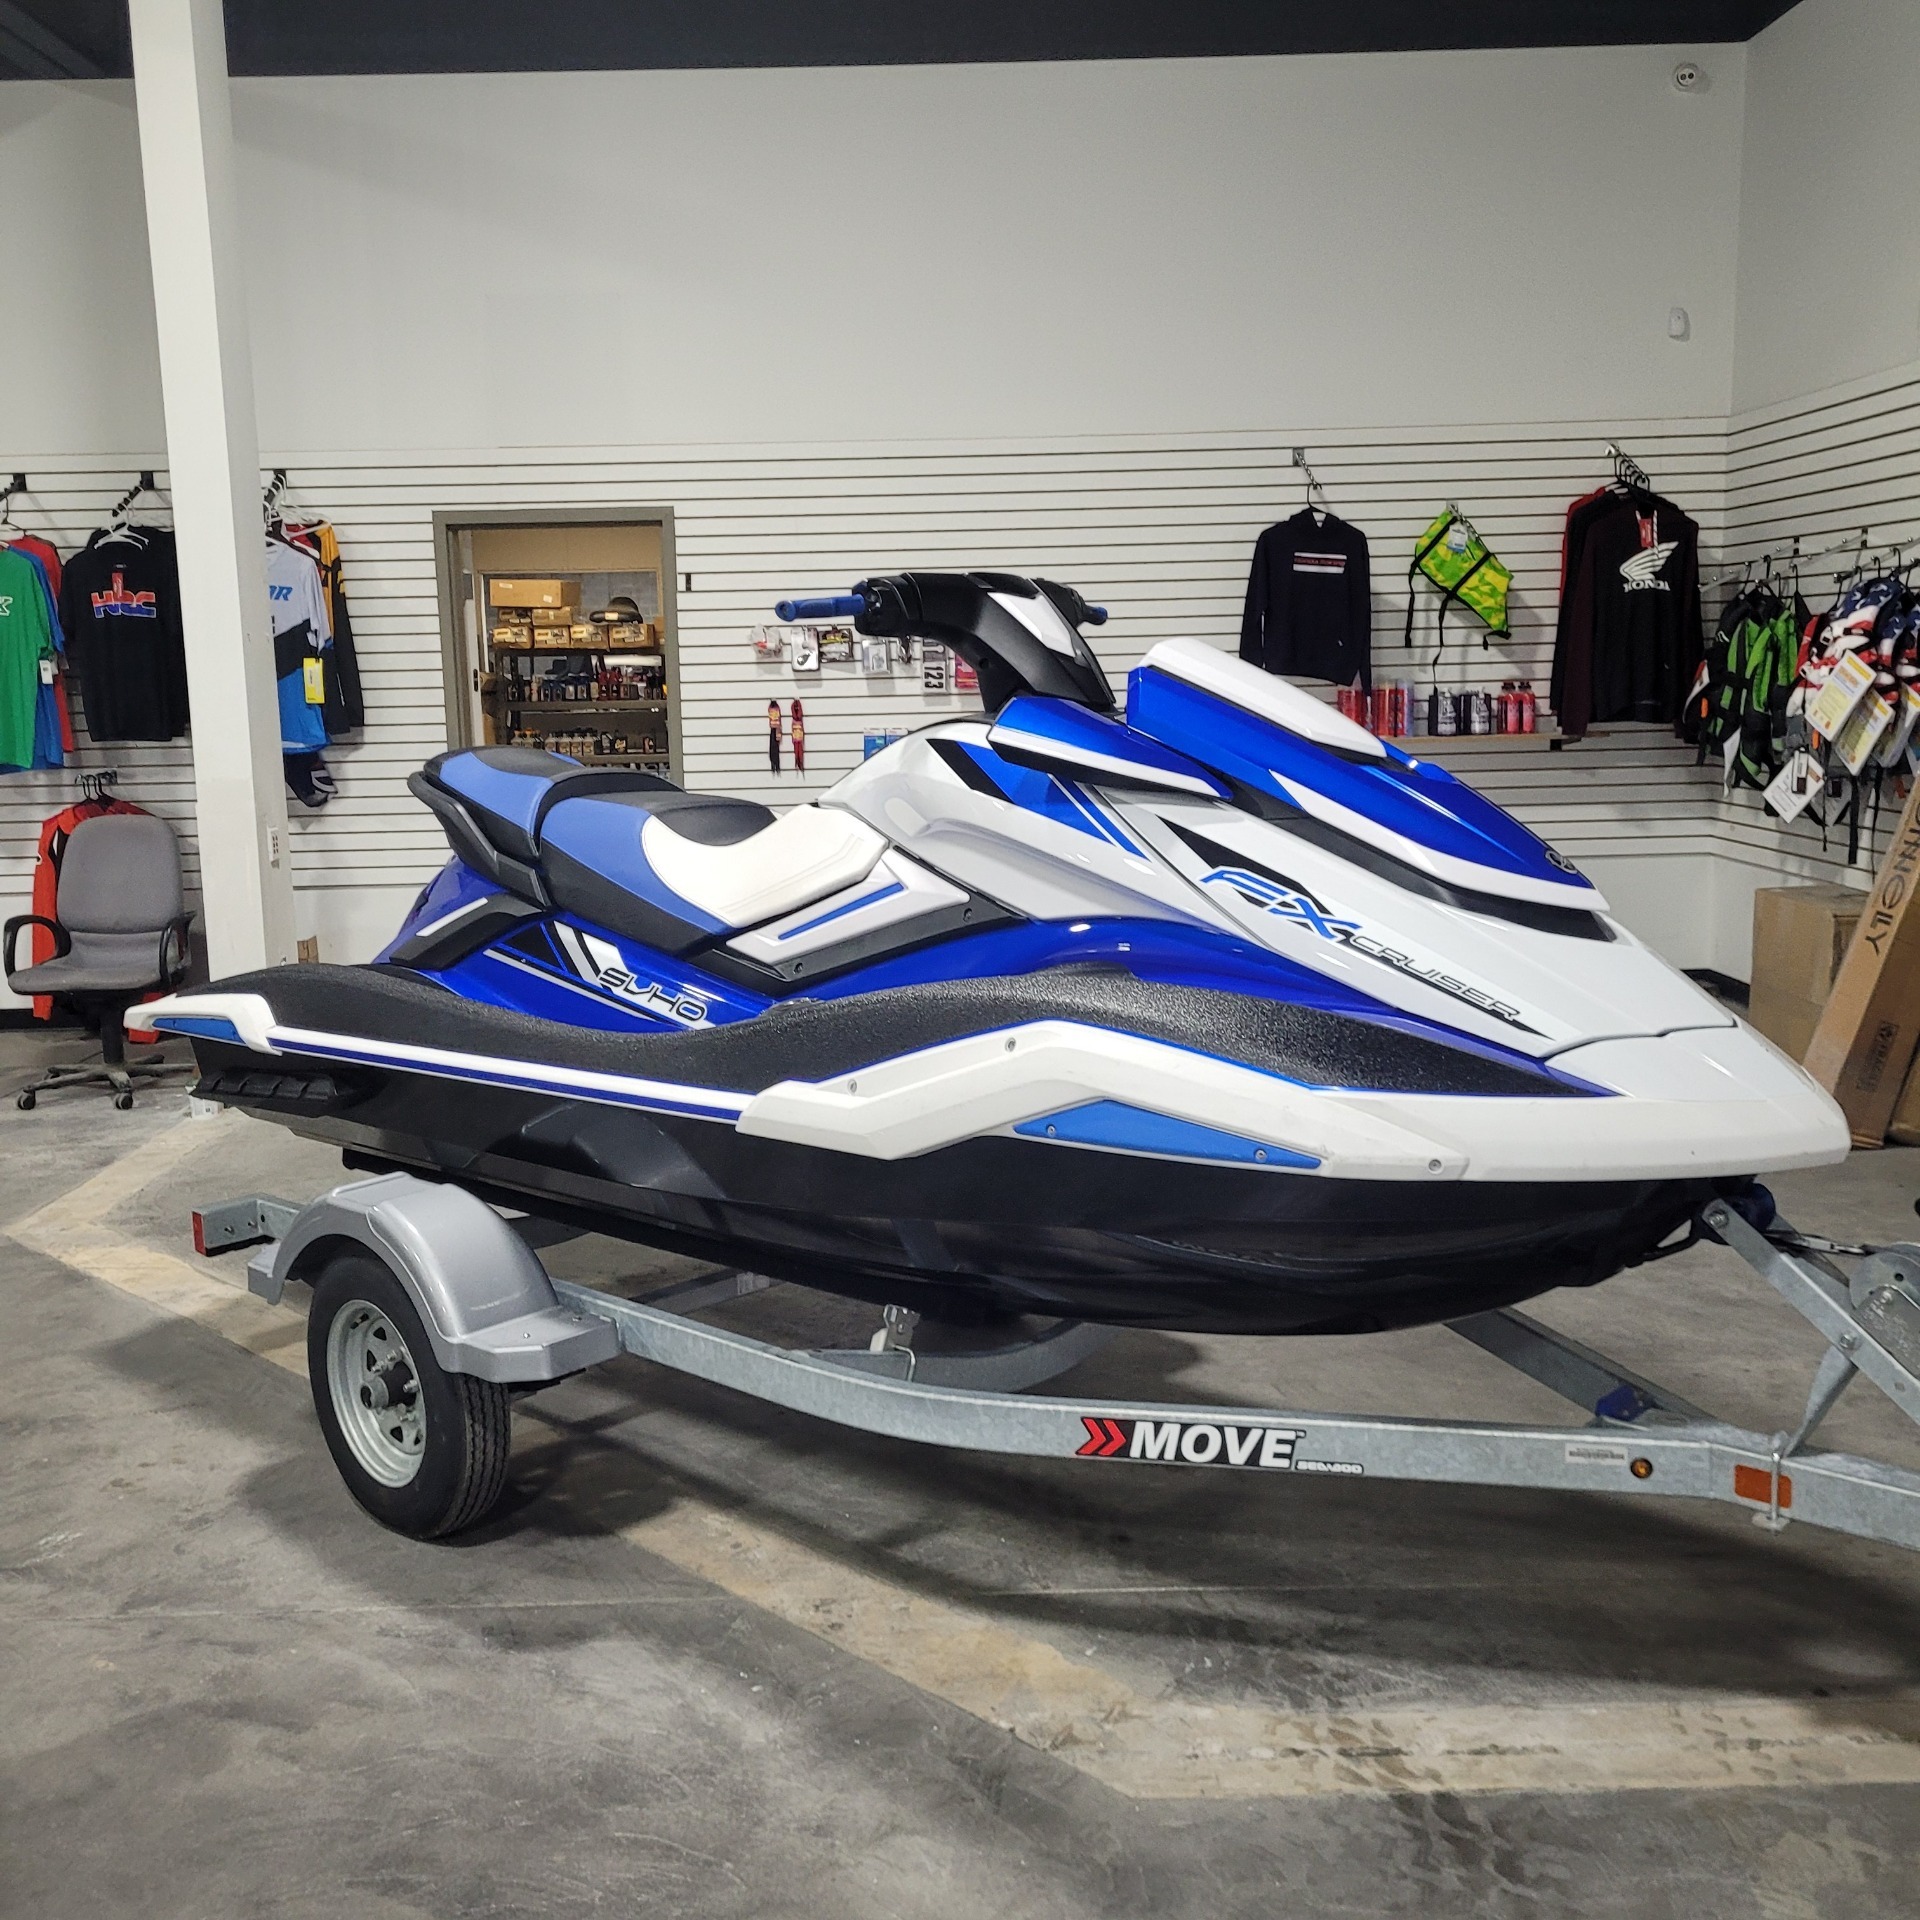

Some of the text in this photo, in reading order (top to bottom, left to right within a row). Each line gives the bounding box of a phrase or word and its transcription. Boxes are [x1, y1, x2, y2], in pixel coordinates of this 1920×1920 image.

[924, 666, 944, 689] 123
[1199, 868, 1521, 1020] FX CRUISER
[599, 966, 706, 1022] SVHO
[1128, 1420, 1297, 1469] MOVE
